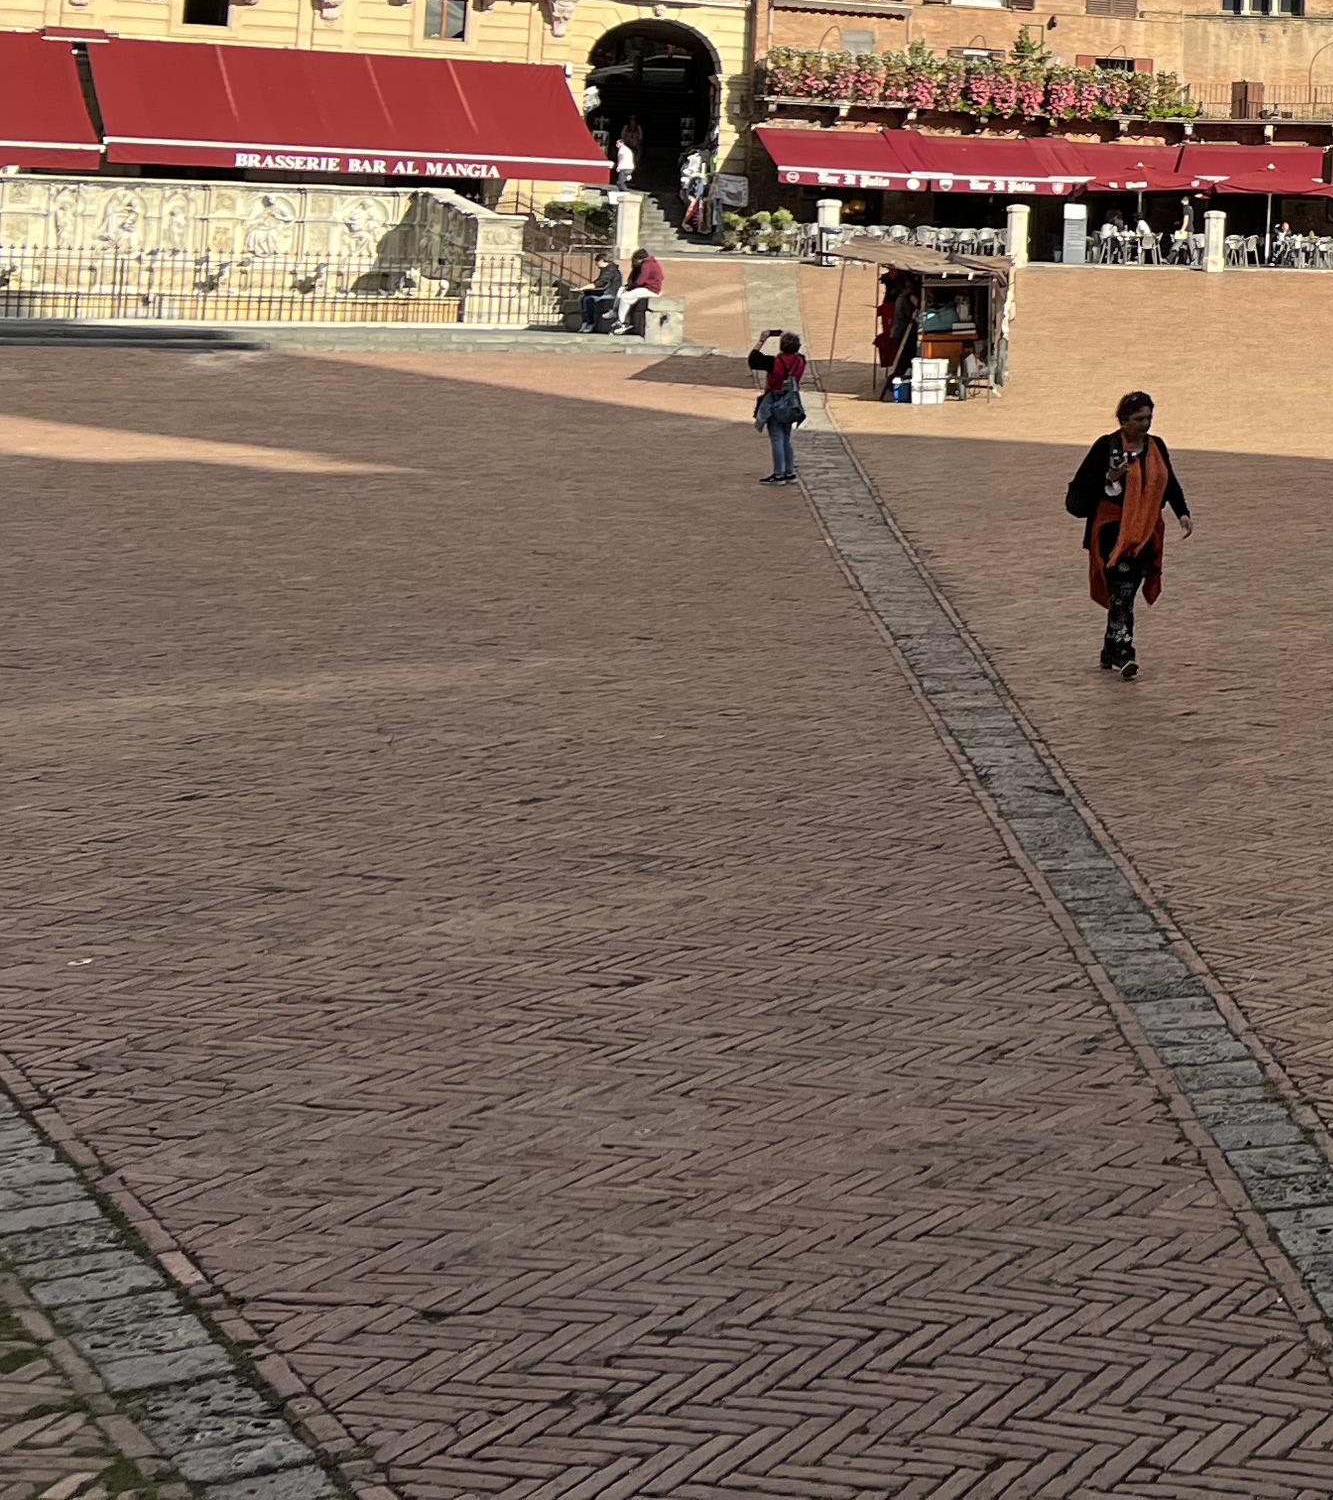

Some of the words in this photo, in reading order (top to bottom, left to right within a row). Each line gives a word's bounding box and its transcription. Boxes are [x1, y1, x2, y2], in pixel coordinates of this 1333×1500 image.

[235, 153, 340, 172] BRASSERIE
[348, 158, 387, 174] BAR
[392, 160, 419, 175] AL
[425, 162, 500, 178] MANGIA
